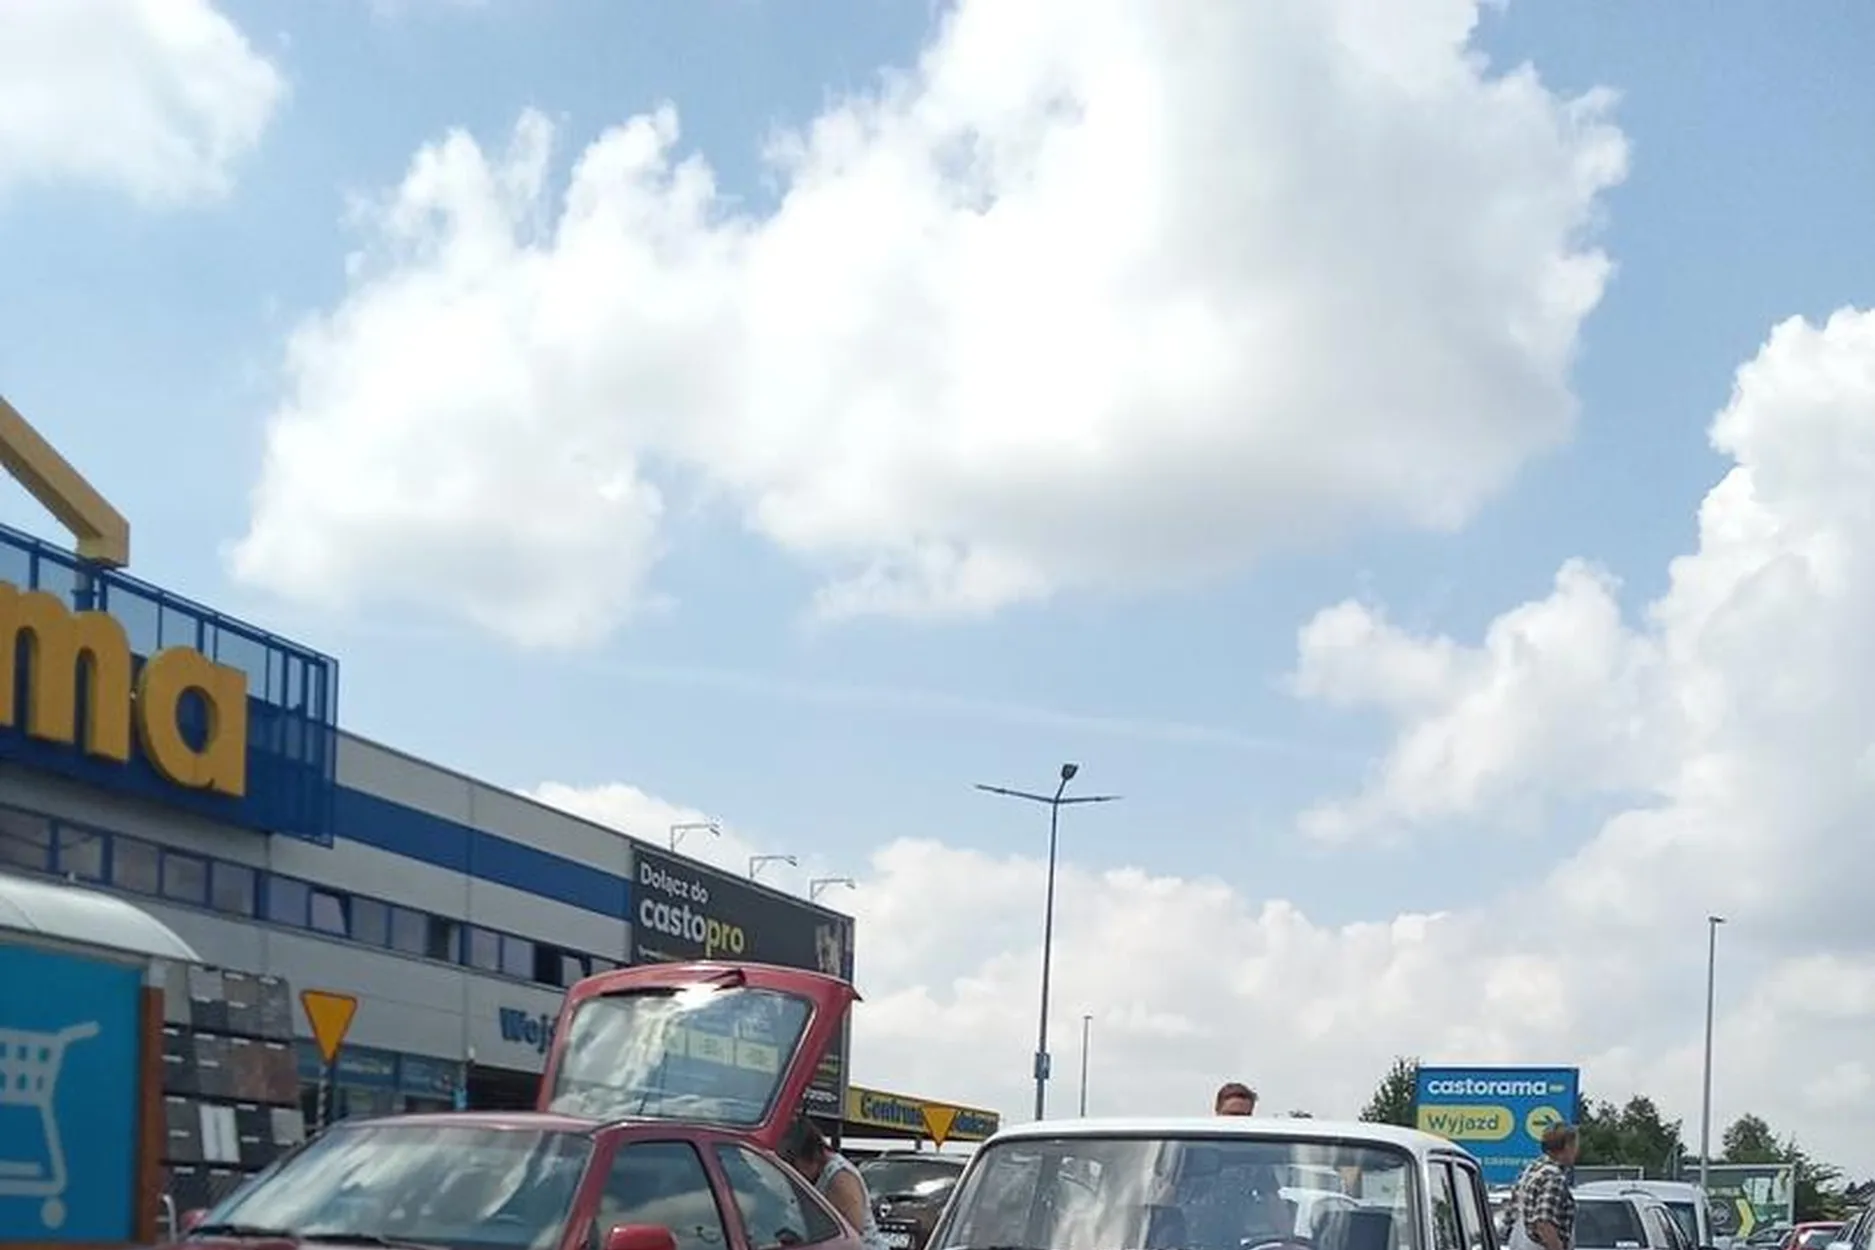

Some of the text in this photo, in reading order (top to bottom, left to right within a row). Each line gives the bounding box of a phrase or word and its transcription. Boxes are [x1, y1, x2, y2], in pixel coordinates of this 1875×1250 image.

[640, 861, 709, 904] Dołącz do
[640, 898, 745, 958] castopro
[1427, 1078, 1547, 1096] castorama
[1427, 1112, 1500, 1134] Wyjazd
